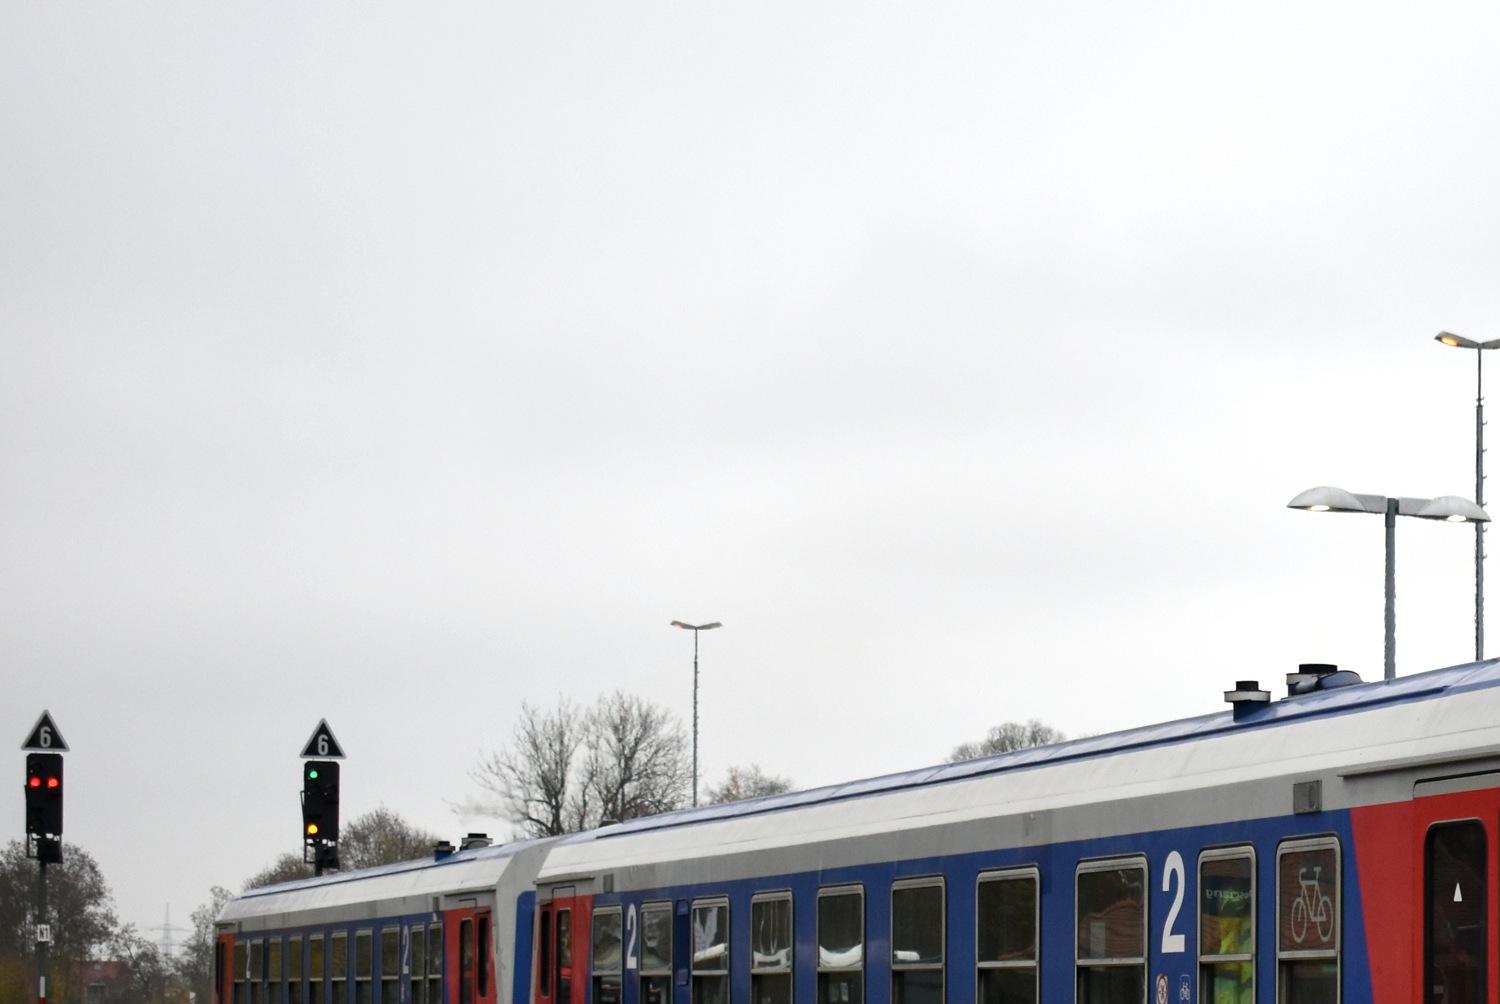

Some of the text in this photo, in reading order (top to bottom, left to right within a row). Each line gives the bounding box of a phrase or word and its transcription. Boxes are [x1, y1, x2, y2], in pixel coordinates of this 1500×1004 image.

[40, 726, 51, 748] 6
[318, 734, 329, 756] 6
[1162, 850, 1185, 953] 2
[402, 925, 409, 975] 2
[626, 903, 637, 969] 2
